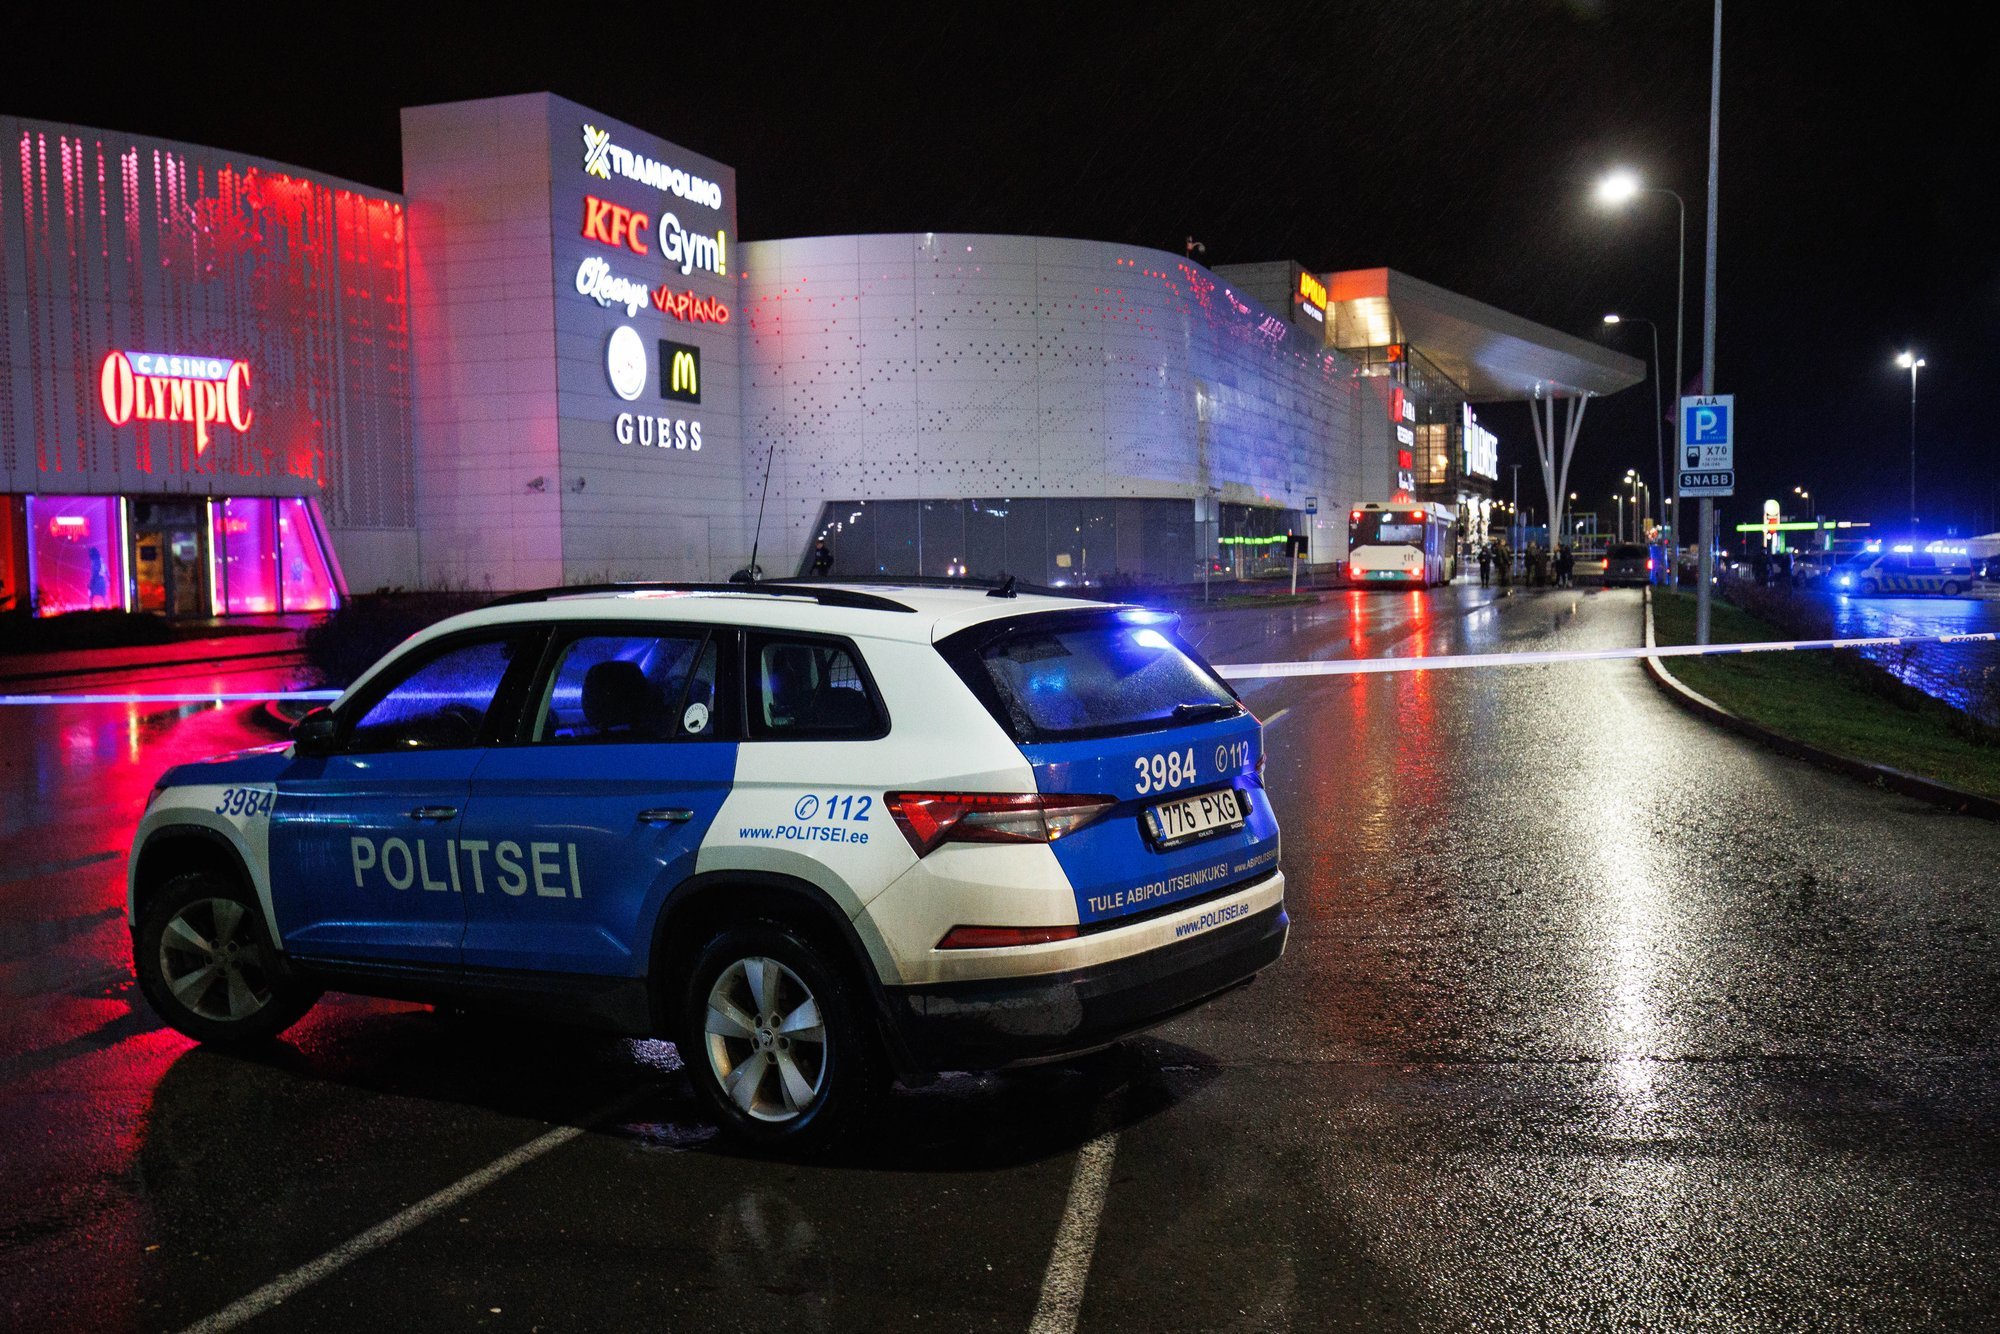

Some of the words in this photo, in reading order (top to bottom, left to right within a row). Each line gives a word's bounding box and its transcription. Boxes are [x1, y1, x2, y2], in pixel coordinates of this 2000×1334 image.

[582, 195, 649, 256] KFC
[659, 212, 726, 276] Gym!
[137, 354, 223, 379] CASINO
[1696, 397, 1718, 406] ALA
[616, 412, 702, 452] GUESS
[1707, 446, 1728, 456] X70
[1684, 474, 1729, 486] SNABB
[1230, 740, 1249, 769] 112
[1134, 748, 1197, 794] 3984
[215, 788, 273, 818] 3984
[826, 794, 873, 822] 112
[1161, 802, 1196, 834] 776
[1200, 792, 1236, 825] PXG
[739, 825, 869, 844] www.POLITSEI.ee
[351, 837, 582, 899] POLITSEI
[1088, 892, 1123, 913] TULE
[1126, 862, 1228, 905] ABIPOLITSEINIKUKS!
[1175, 903, 1249, 937] www.POLITSEI.ee
